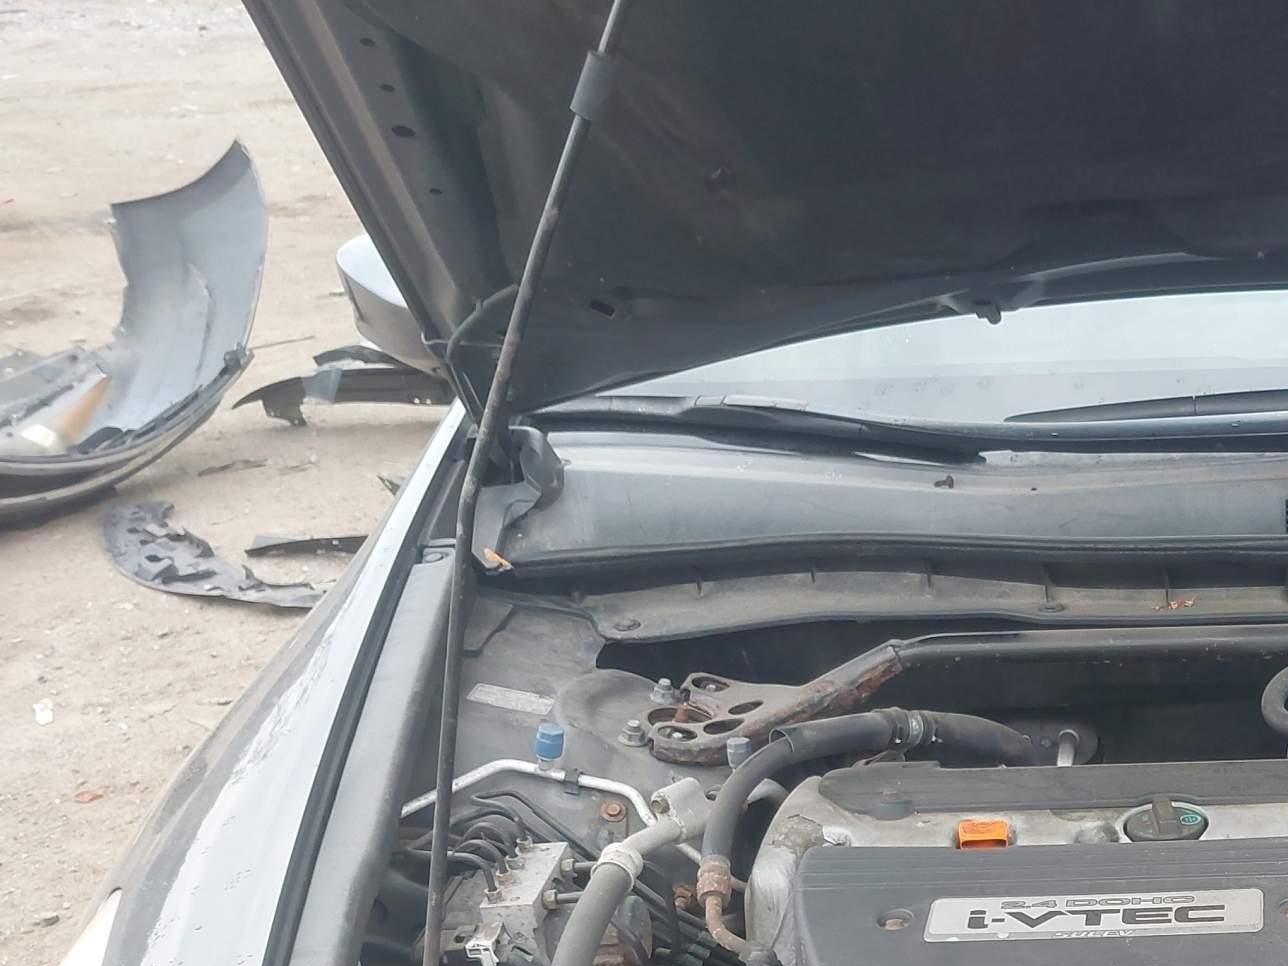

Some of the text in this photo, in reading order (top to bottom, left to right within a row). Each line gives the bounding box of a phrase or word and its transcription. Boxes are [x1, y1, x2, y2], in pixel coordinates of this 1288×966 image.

[1000, 894, 1195, 910] 2.4 DOHC
[967, 904, 1225, 929] i-VTEC
